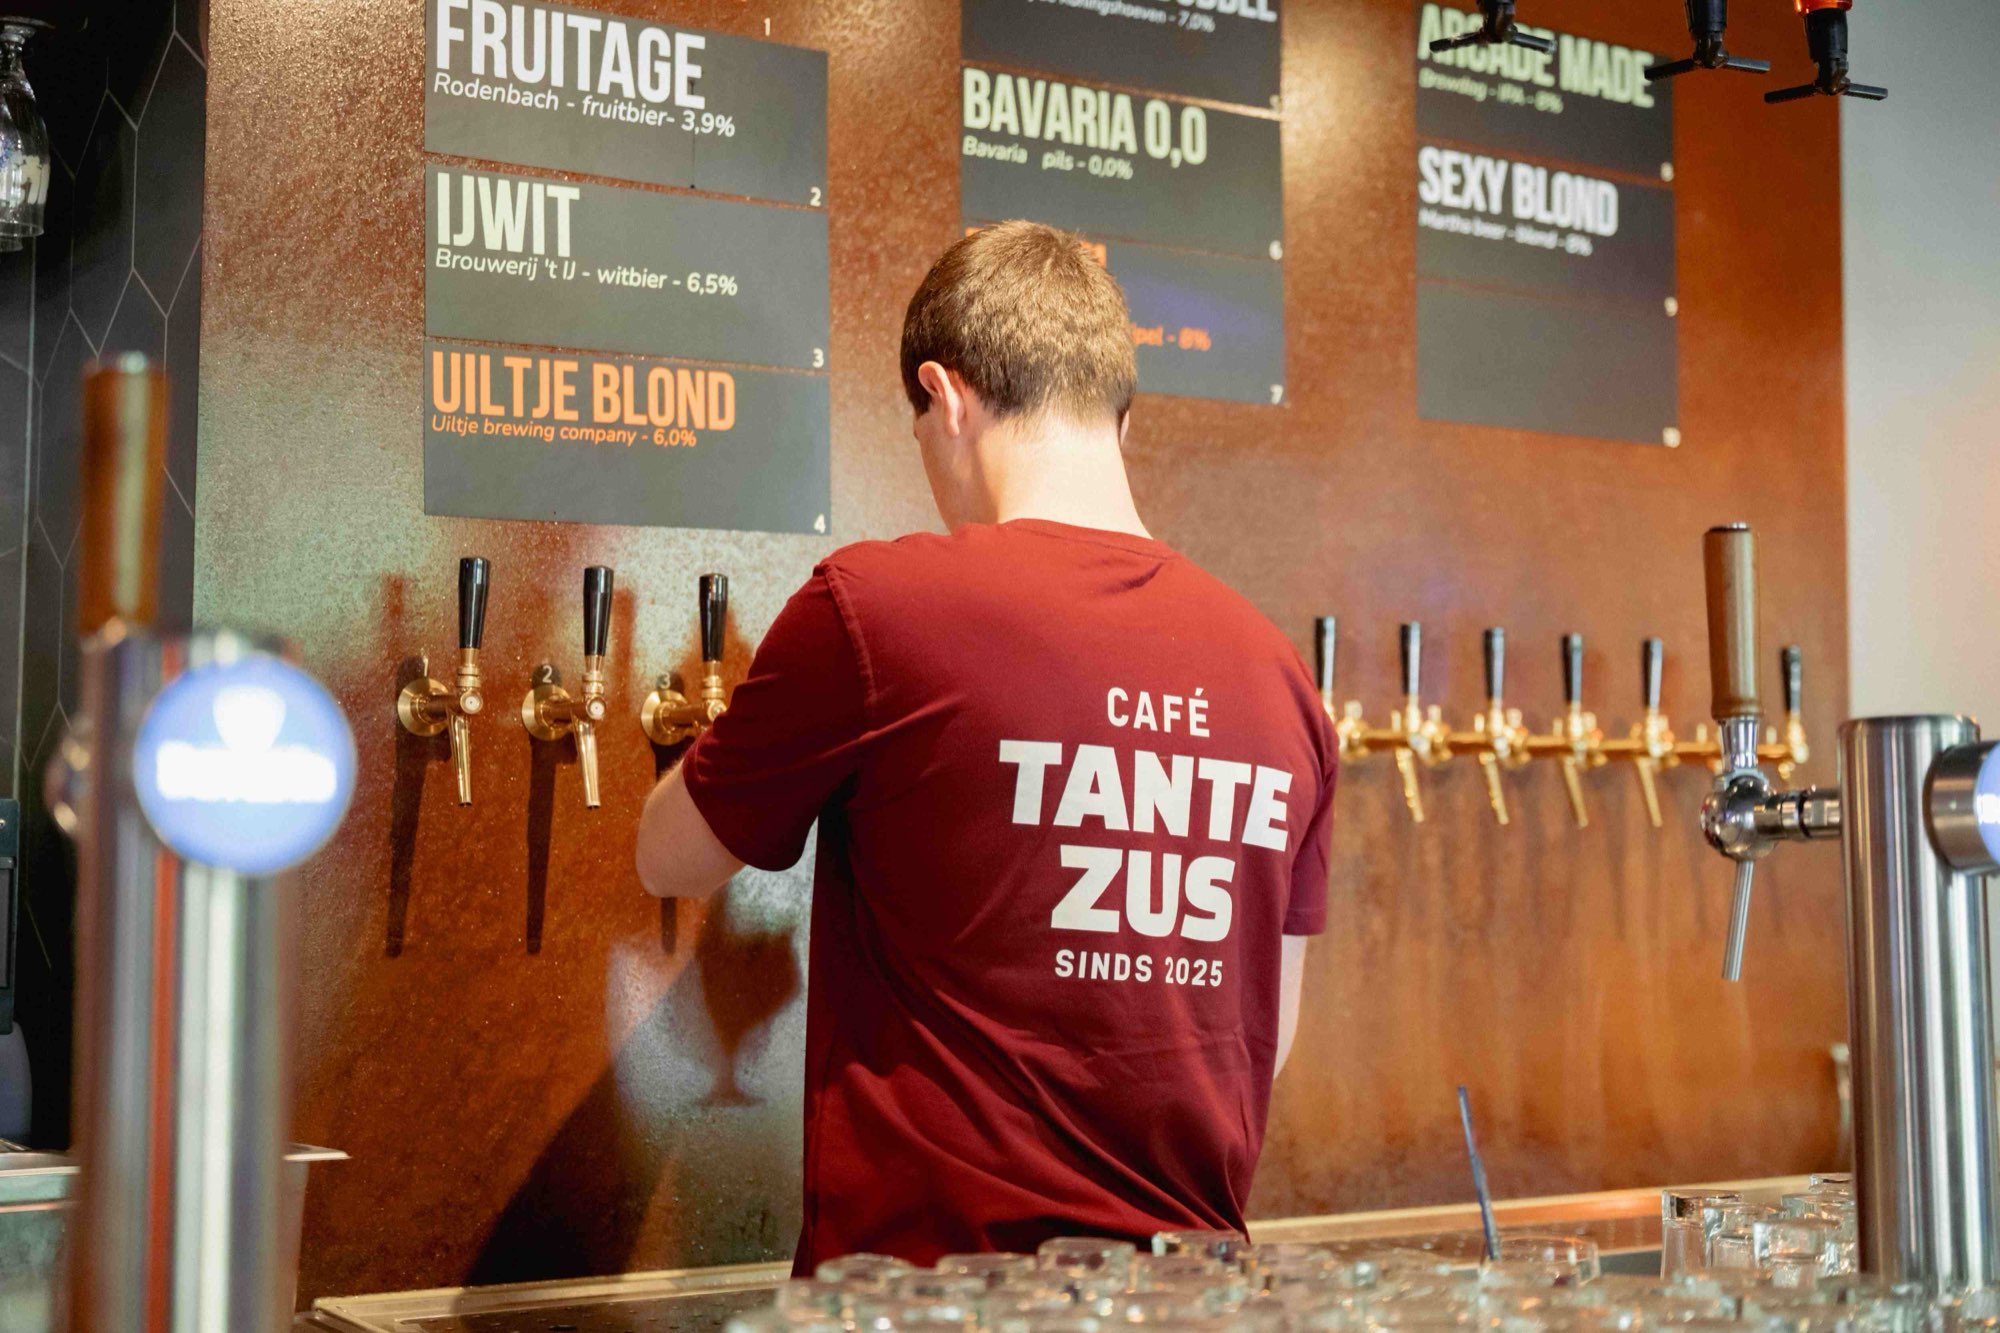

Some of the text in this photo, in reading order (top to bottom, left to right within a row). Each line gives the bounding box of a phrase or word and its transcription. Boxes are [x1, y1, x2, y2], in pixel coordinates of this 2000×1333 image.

[764, 18, 771, 36] 1
[437, 0, 706, 110] FRUITAGE
[1559, 34, 1655, 109] MADE
[434, 73, 559, 111] Rodenbach
[681, 110, 735, 137] 3,9%
[963, 67, 1208, 168] BAVARIA 0,0
[962, 135, 1028, 164] Bavaria
[1042, 150, 1074, 171] pils
[1088, 156, 1134, 181] 0,0%
[437, 172, 580, 258] IJWIT
[810, 187, 821, 207] 2
[1418, 146, 1618, 237] SEXY BLOND
[435, 249, 538, 281] Brouwerij
[563, 262, 576, 281] IJ
[598, 266, 667, 290] witbier
[687, 272, 738, 297] 6,5%
[812, 349, 824, 368] 3
[432, 351, 736, 431] UILTJE BLOND
[432, 414, 478, 437] Uiltje
[483, 419, 554, 442] brewing
[560, 427, 636, 447] company
[653, 428, 697, 447] 6,0%
[813, 514, 826, 533] 4
[542, 665, 553, 684] 2
[660, 672, 672, 690] 3
[1107, 687, 1210, 737] CAFÉ
[999, 739, 1293, 852] TANTE
[1051, 844, 1236, 942] ZUS
[1055, 949, 1223, 987] SINDS 2025
